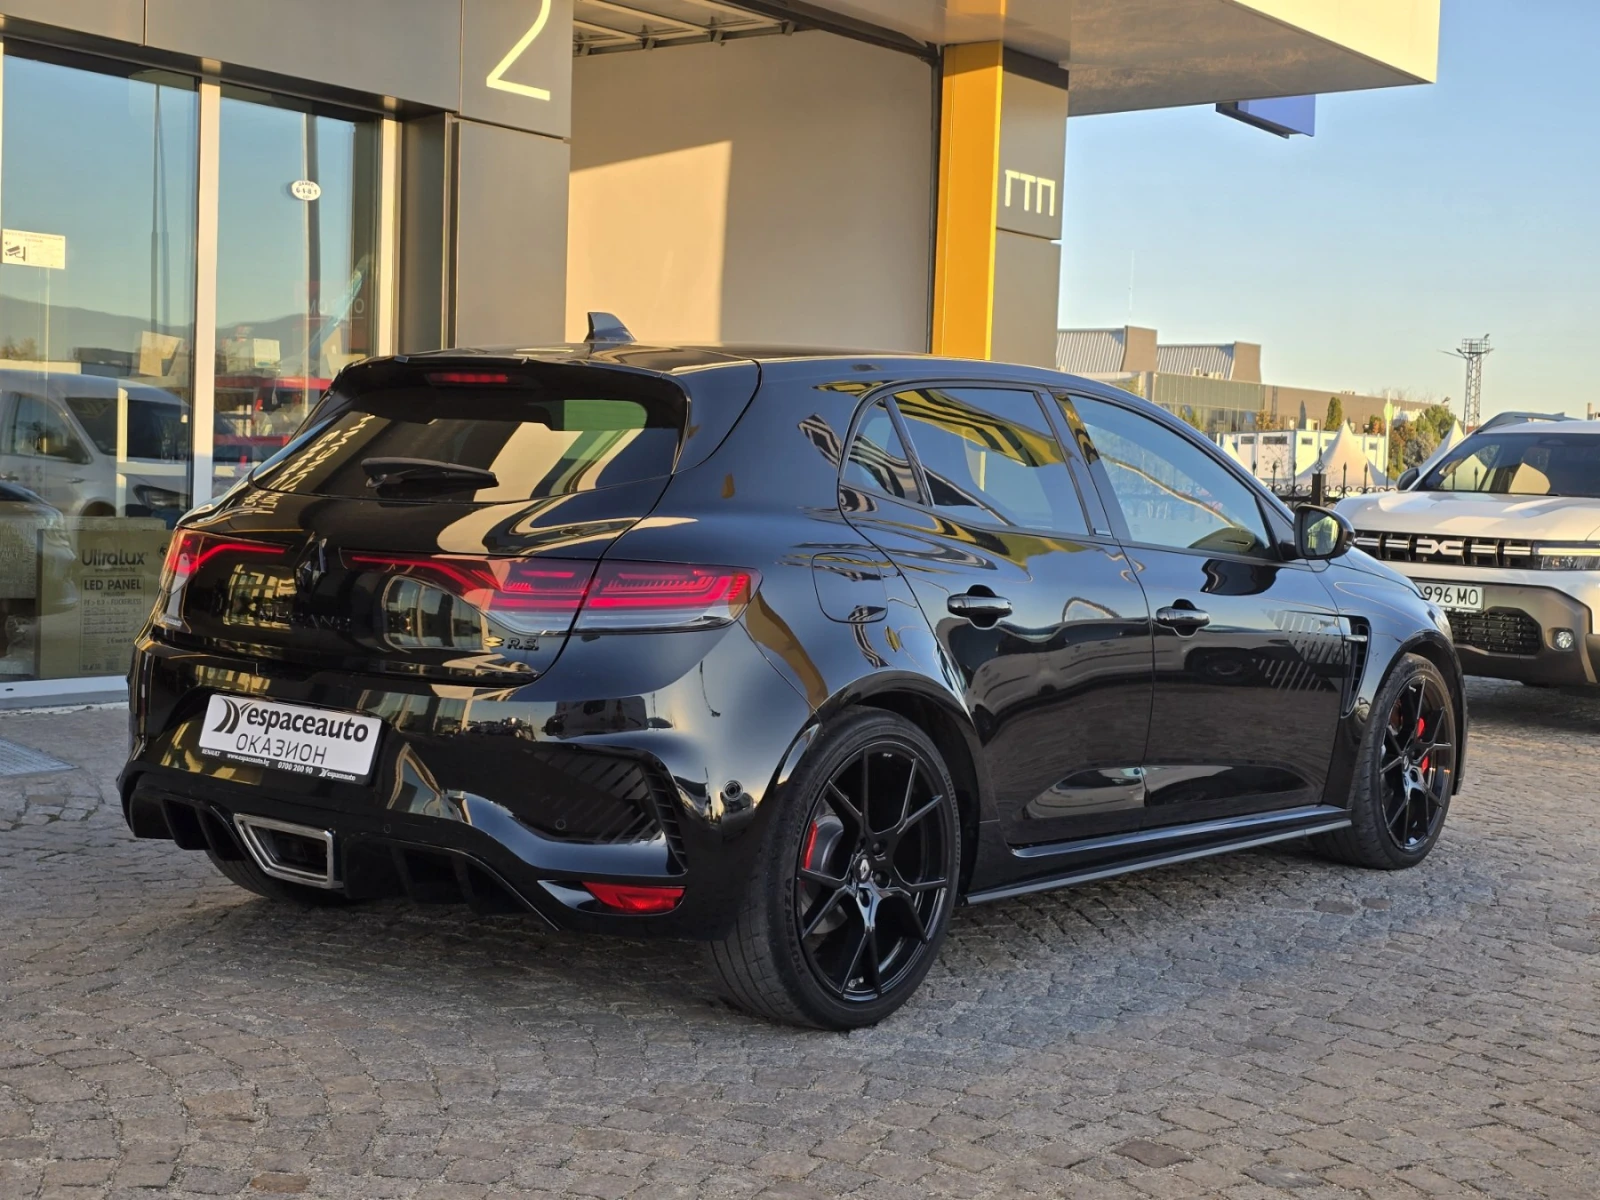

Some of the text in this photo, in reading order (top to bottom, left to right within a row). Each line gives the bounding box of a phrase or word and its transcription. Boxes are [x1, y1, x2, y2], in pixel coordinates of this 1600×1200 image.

[1004, 168, 1056, 217] ГТП
[84, 578, 142, 591] LED PANEL
[1423, 586, 1478, 605] 996 MO
[507, 637, 539, 651] R.S.
[246, 706, 369, 743] espaceauto
[235, 732, 328, 765] ОКАЗИОН
[277, 761, 291, 771] 0700
